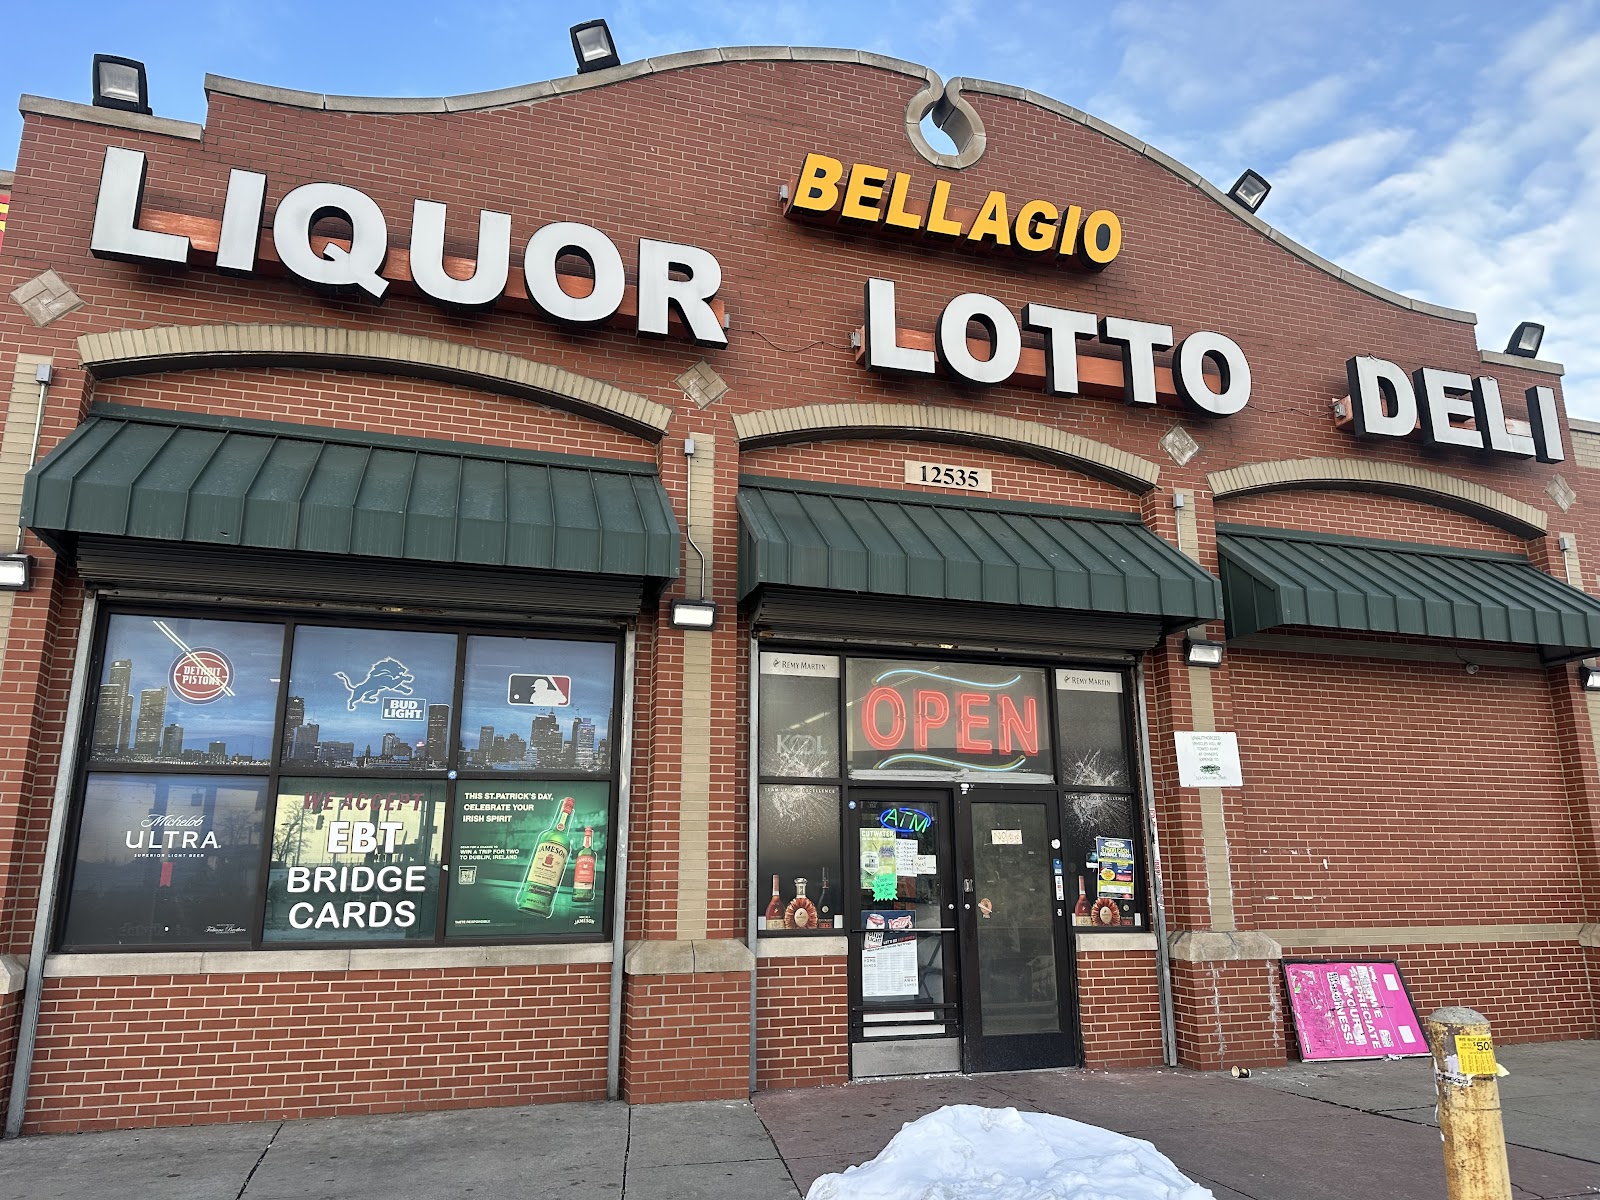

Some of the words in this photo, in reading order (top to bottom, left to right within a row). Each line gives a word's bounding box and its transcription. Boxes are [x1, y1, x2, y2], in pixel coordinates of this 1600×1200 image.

[794, 152, 1122, 265] BELLAGIO
[91, 146, 728, 349] LIQUOR
[866, 278, 1252, 417] LOTTO
[1348, 356, 1564, 463] DELI
[920, 465, 979, 488] 12535
[184, 665, 222, 676] DETROIT
[800, 661, 826, 670] MARTIN
[182, 675, 221, 686] PISTONS
[383, 708, 423, 719] LIGHT
[390, 699, 418, 710] BUD
[862, 687, 1039, 757] OPEN
[304, 792, 336, 811] WE
[341, 793, 425, 811] ACCEPT
[464, 792, 483, 800] THIS
[484, 792, 537, 800] ST.PATRICK'S
[537, 793, 554, 801] DAY,
[463, 803, 511, 811] CELEBRATE
[140, 813, 207, 828] Michelob
[486, 815, 513, 823] SPIRIT
[883, 808, 929, 833] ATM
[125, 830, 220, 849] ULTRA
[327, 820, 404, 854] EBT
[286, 865, 427, 893] BRIDGE
[288, 900, 416, 929] CARDS
